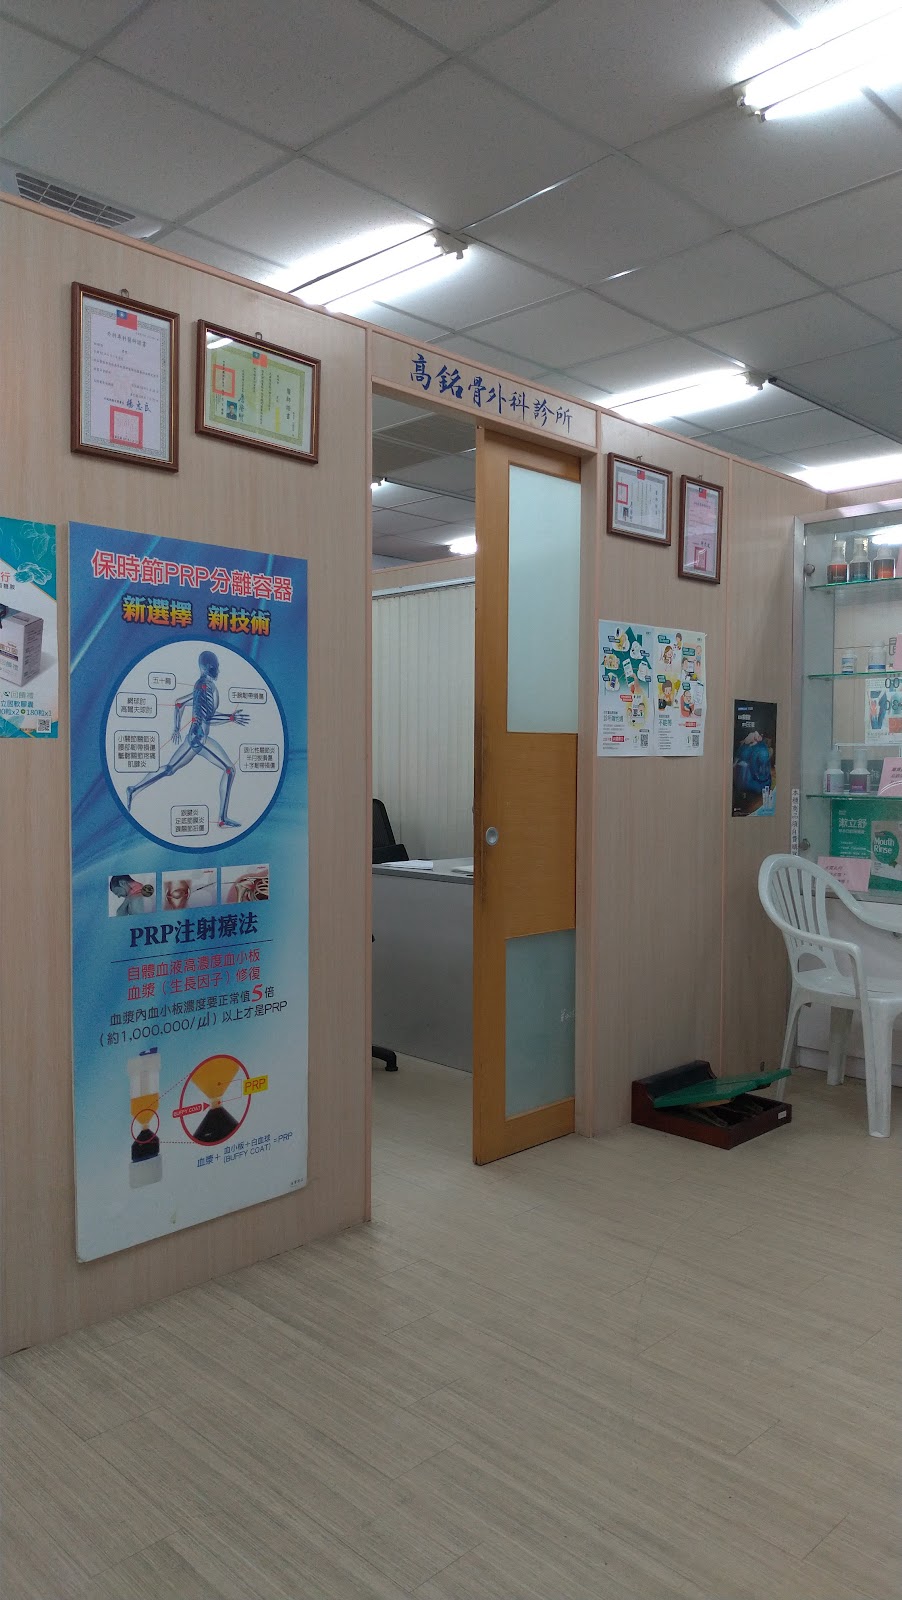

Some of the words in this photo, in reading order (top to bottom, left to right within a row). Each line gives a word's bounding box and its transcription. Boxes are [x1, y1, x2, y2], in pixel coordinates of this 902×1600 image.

[410, 353, 573, 434] 高銘骨外科診所
[91, 548, 293, 603] 保時節PRP分離容器
[122, 594, 193, 628] 新選擇
[207, 604, 271, 636] 新技術
[873, 837, 895, 847] Mouth
[873, 844, 893, 855] Rinse
[129, 912, 259, 948] PRP注射療法
[127, 948, 261, 982] 自體血液高濃度血小板
[244, 1078, 266, 1093] PRP
